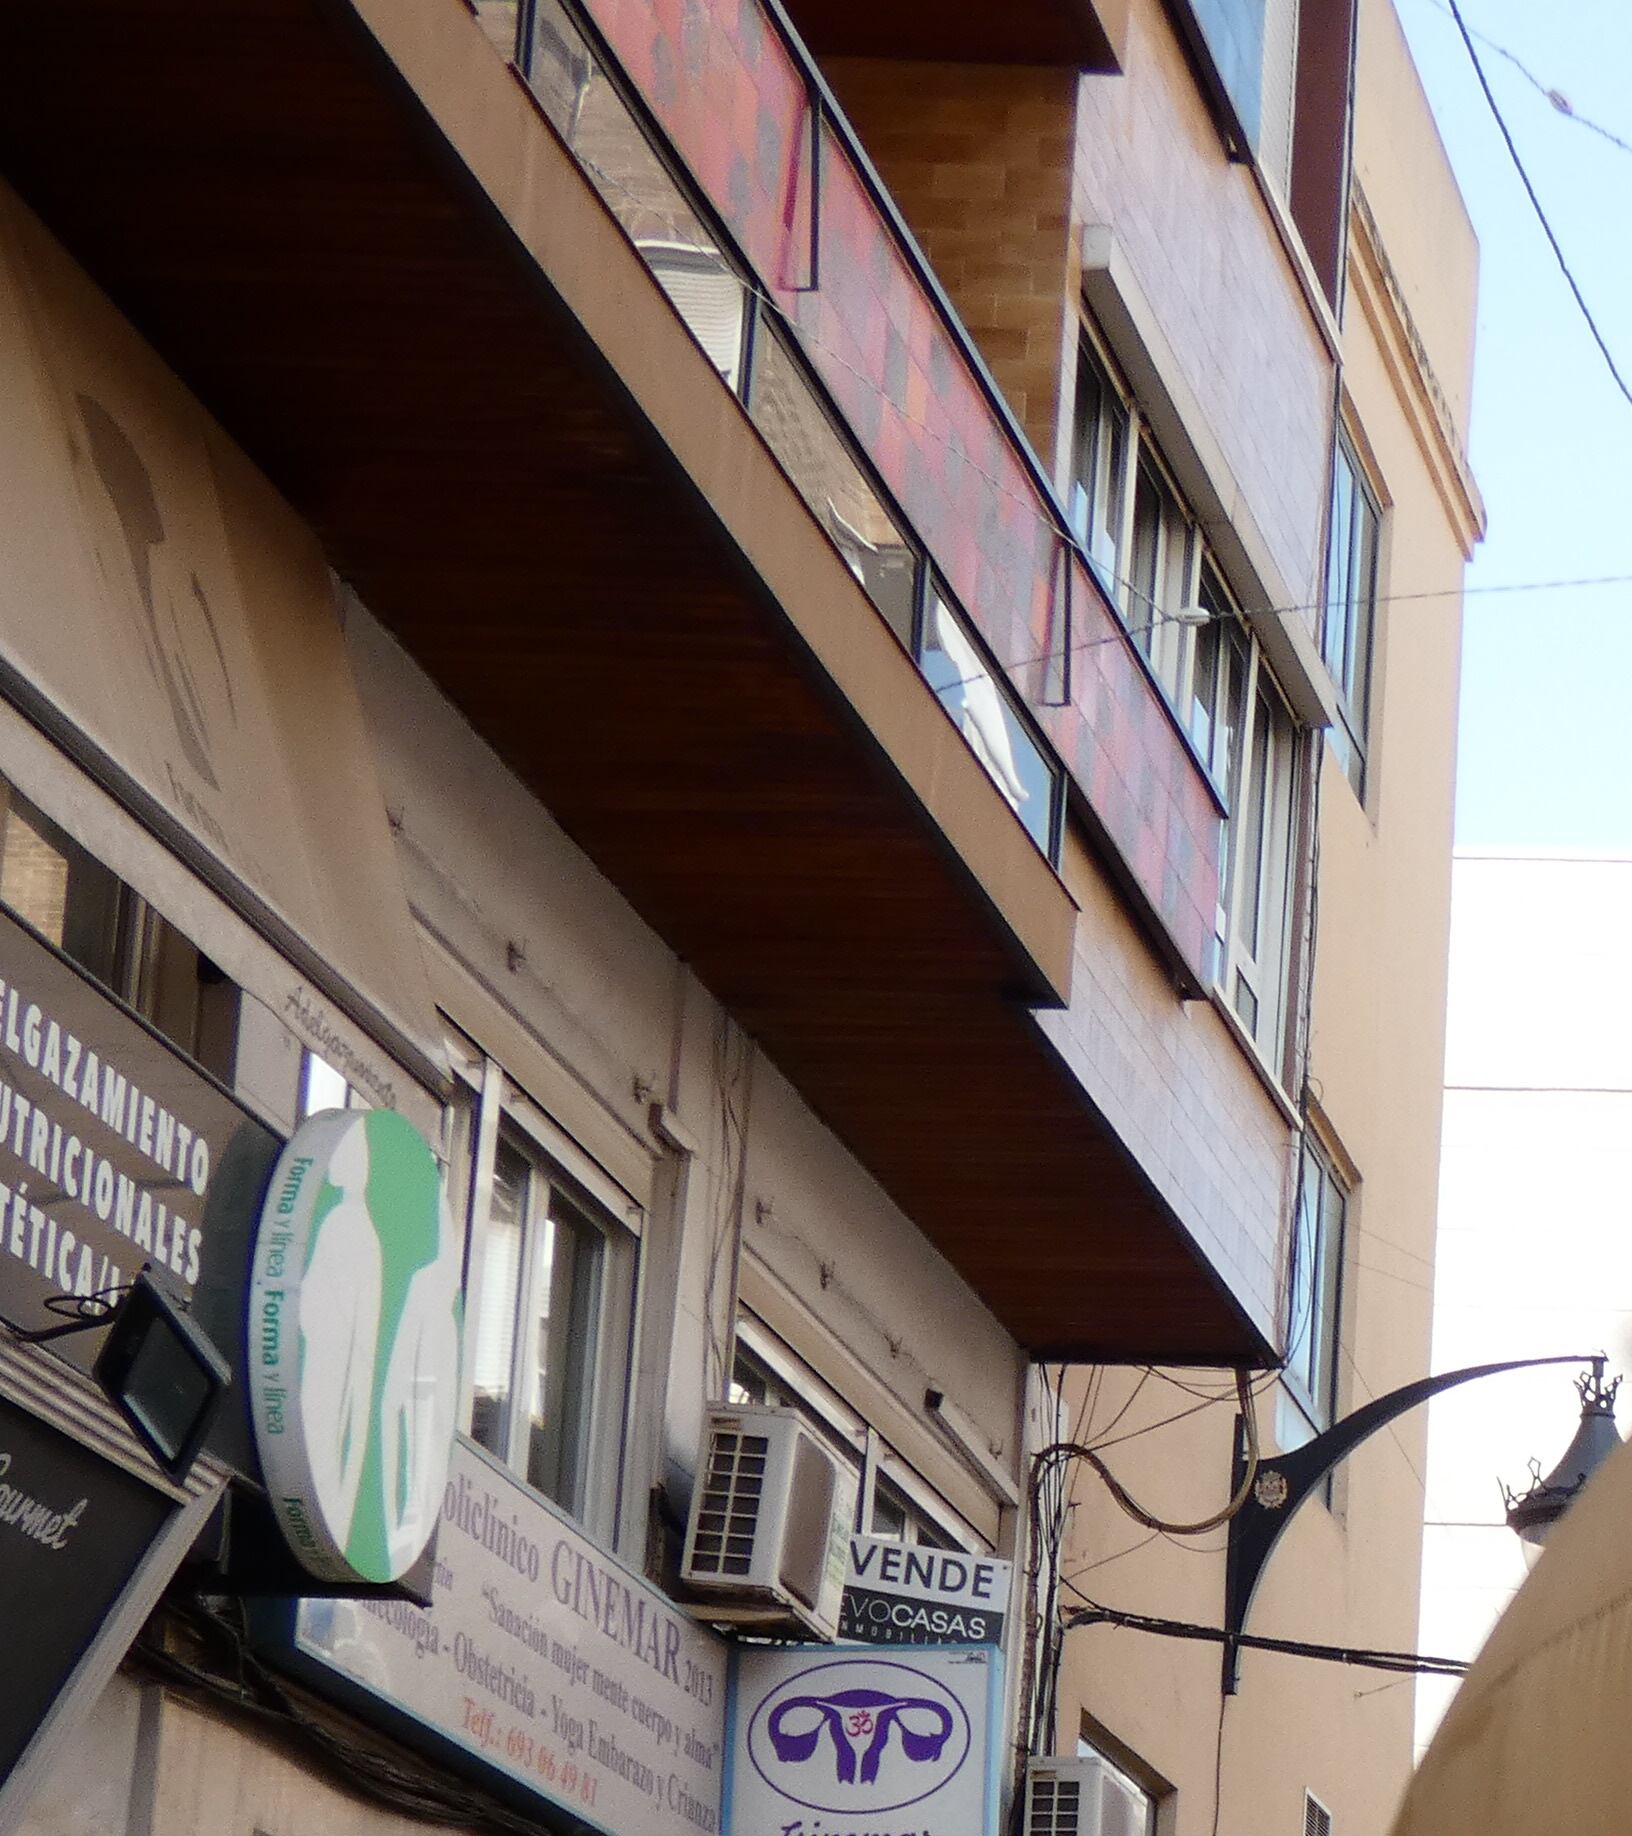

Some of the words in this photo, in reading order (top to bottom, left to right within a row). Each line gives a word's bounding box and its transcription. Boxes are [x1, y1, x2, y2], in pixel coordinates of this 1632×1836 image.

[277, 1157, 315, 1214] Forma
[261, 1289, 285, 1366] Forma
[443, 1473, 539, 1582] oliclínico
[551, 1540, 683, 1686] GINEMAR
[850, 1540, 995, 1599] VENDE
[507, 1726, 534, 1768] 693
[552, 1695, 584, 1756] Yoga
[588, 1719, 654, 1795] Embarazo
[631, 1696, 673, 1745] cuerpo
